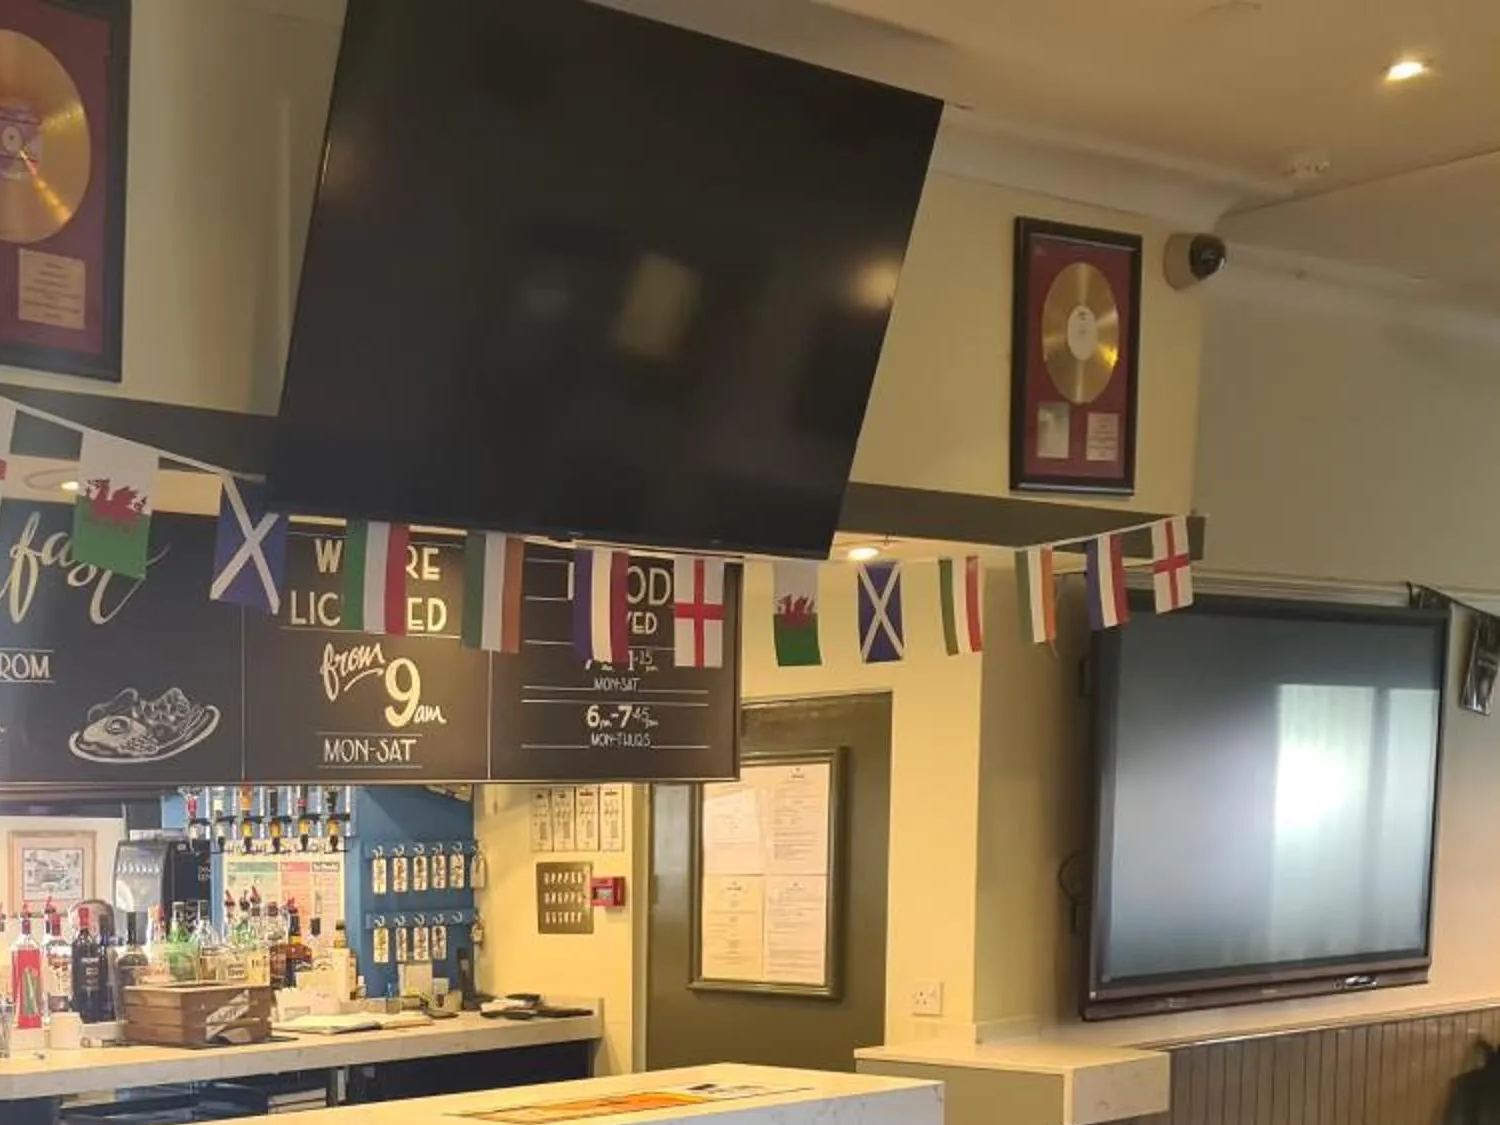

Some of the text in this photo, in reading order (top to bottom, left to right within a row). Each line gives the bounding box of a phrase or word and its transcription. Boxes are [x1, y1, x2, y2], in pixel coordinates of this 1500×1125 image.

[291, 590, 448, 632] LICED
[320, 642, 386, 702] from
[323, 738, 417, 764] MON-SAT
